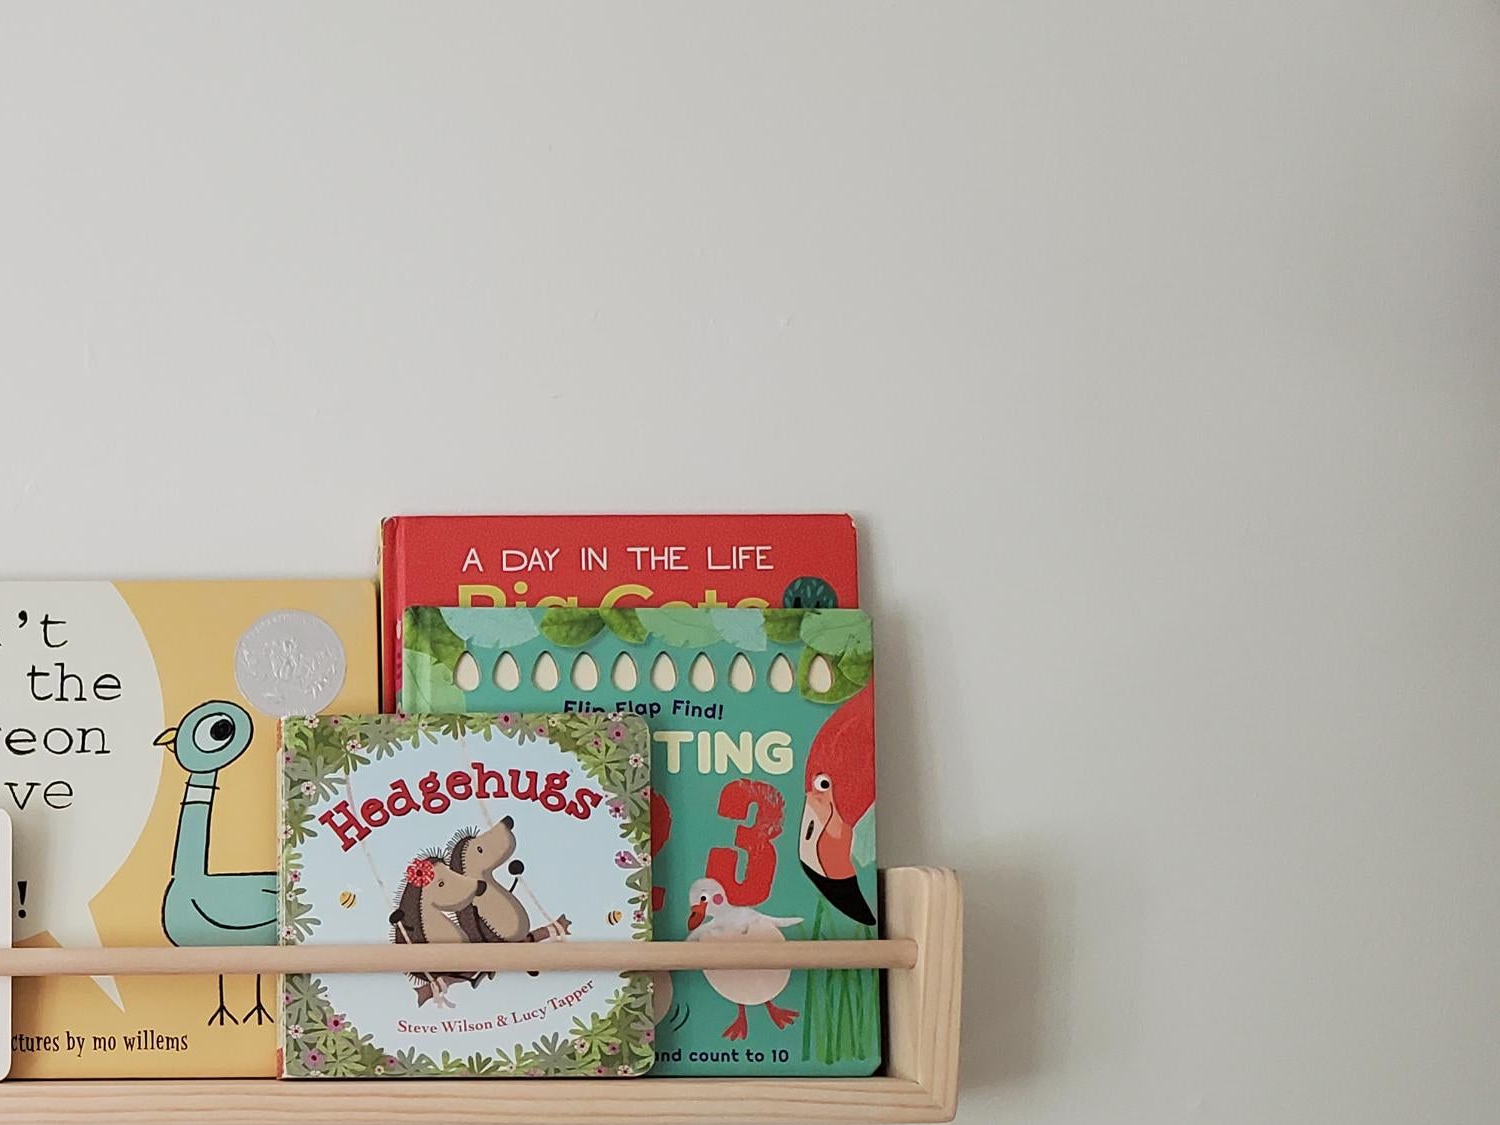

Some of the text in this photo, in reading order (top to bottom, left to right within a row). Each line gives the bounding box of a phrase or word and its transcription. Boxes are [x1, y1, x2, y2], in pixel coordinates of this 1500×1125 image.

[462, 545, 774, 572] A DAY IN THE LIFE
[28, 663, 122, 702] the
[672, 699, 724, 720] Find!
[652, 730, 795, 775] TING
[319, 762, 603, 852] Hedgehugs
[396, 978, 596, 1034] Steve Wilson & Lucy Tapper
[11, 1029, 189, 1058] ctures by mo willems
[689, 1048, 739, 1062] count
[746, 1048, 764, 1062] to
[771, 1048, 789, 1062] 10
